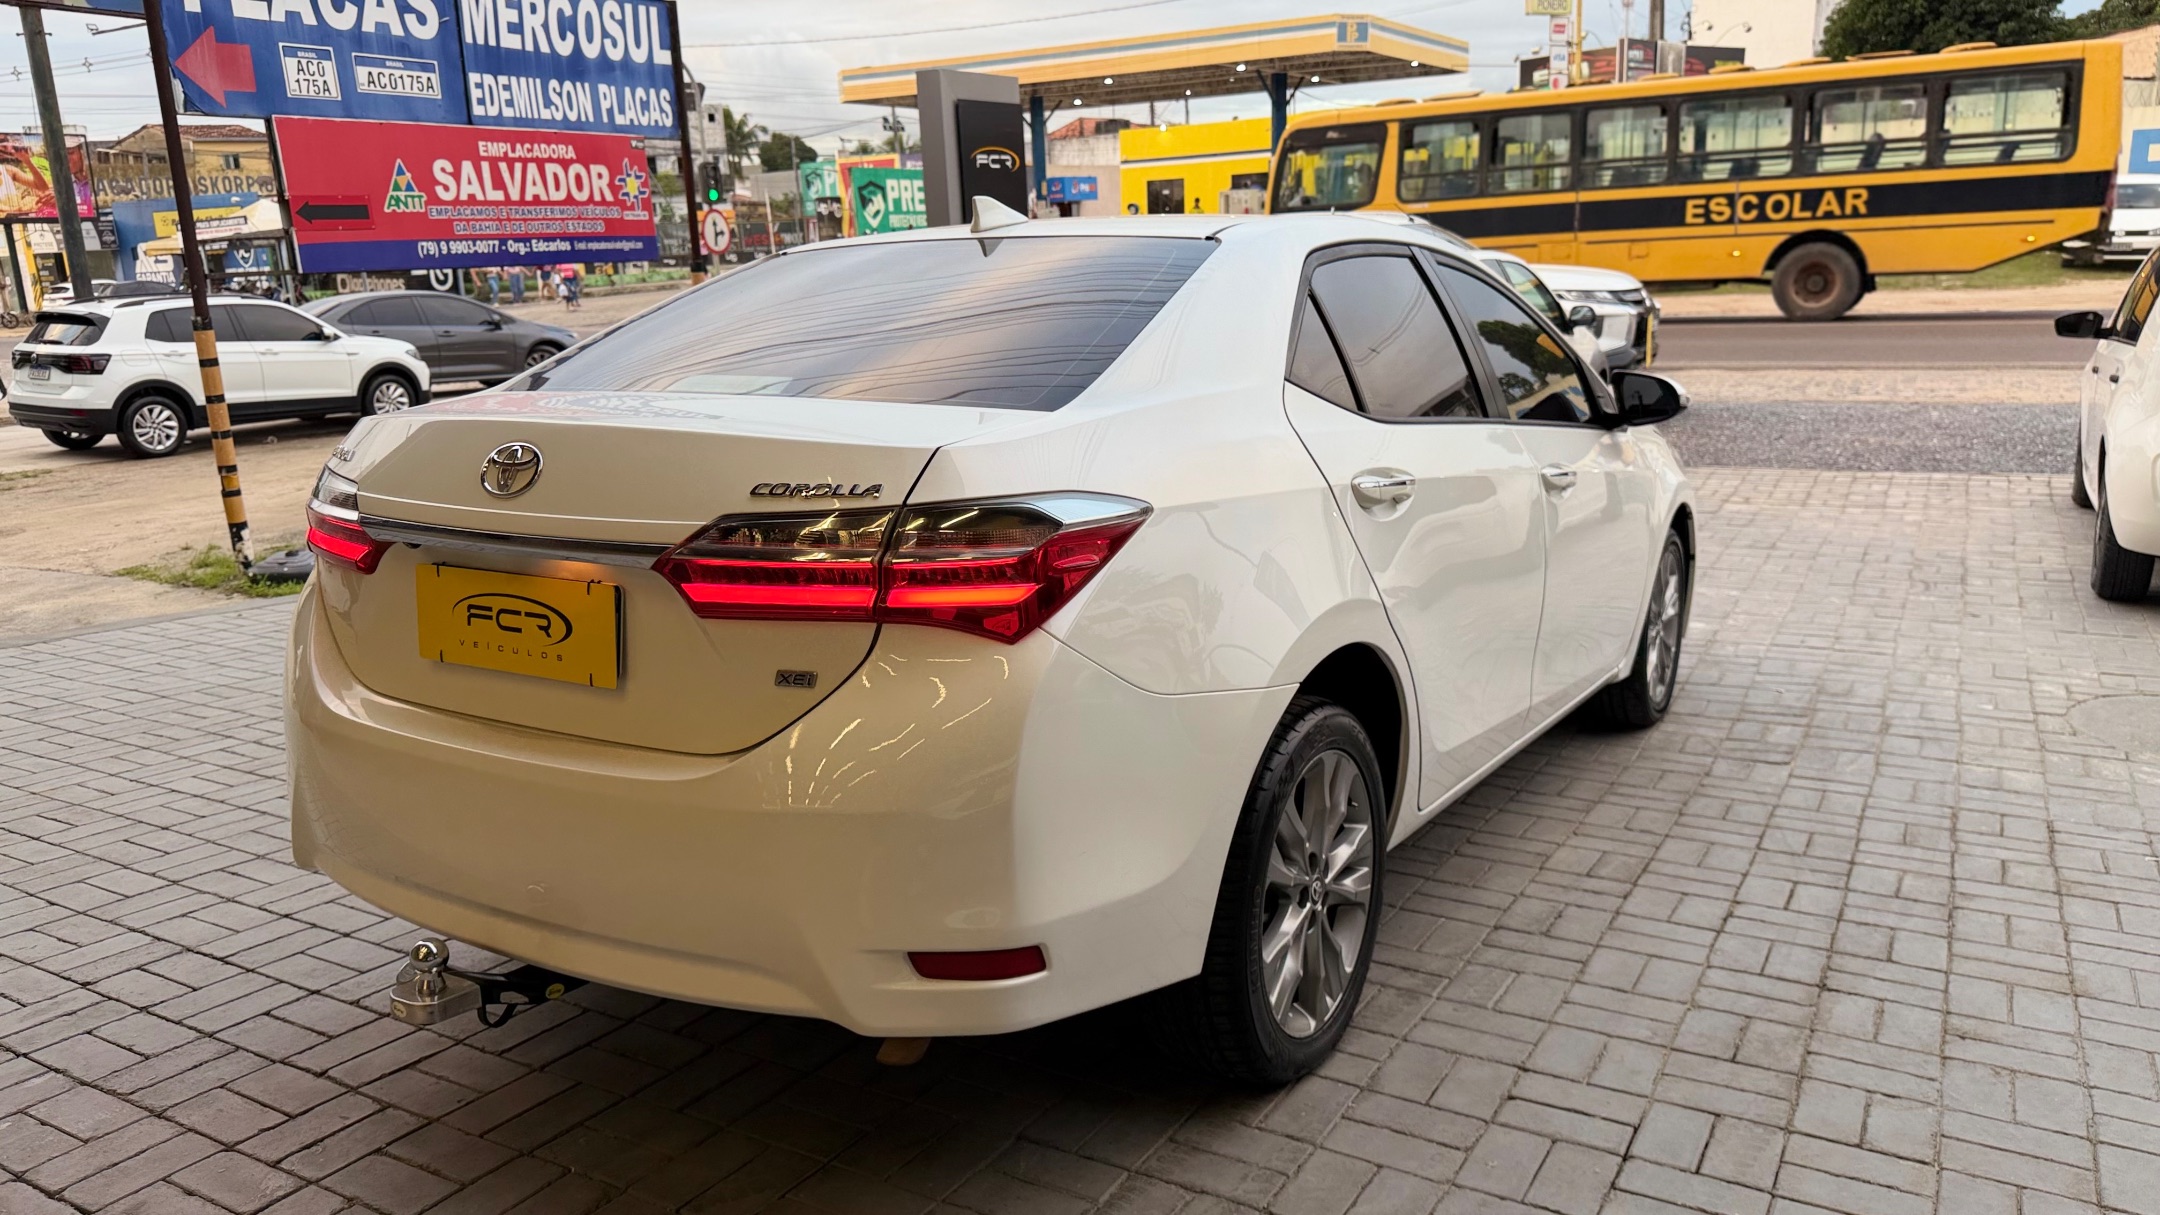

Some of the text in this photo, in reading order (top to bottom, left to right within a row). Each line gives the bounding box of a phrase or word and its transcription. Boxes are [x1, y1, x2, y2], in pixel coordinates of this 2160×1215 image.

[184, 0, 440, 40] LACAS
[461, 0, 673, 66] MERCOSUL
[294, 78, 332, 96] 175A
[468, 72, 673, 127] EDEMILSON PLACAS
[478, 140, 576, 160] EMPLACADORA
[976, 154, 1013, 169] FCR
[433, 158, 614, 203] SALVADOR
[387, 194, 424, 210] ANTT
[428, 206, 498, 219] EMPLACAMOS
[499, 207, 507, 218] E
[508, 206, 578, 219] TRANSFERIMOS
[579, 204, 622, 218] VEÍCULOS
[1685, 188, 1868, 224] ESCOLAR
[454, 219, 606, 233] DA BAHIA E DE OUTROS ESTADOS
[418, 242, 439, 259] (79)
[441, 243, 449, 255] 9
[449, 240, 499, 255] 9903-0077
[508, 240, 531, 256] Org.:
[532, 239, 571, 252] Edcarlos
[750, 482, 883, 499] COROLLA
[467, 603, 552, 638] FCR
[459, 639, 563, 662] VEÍCULOS
